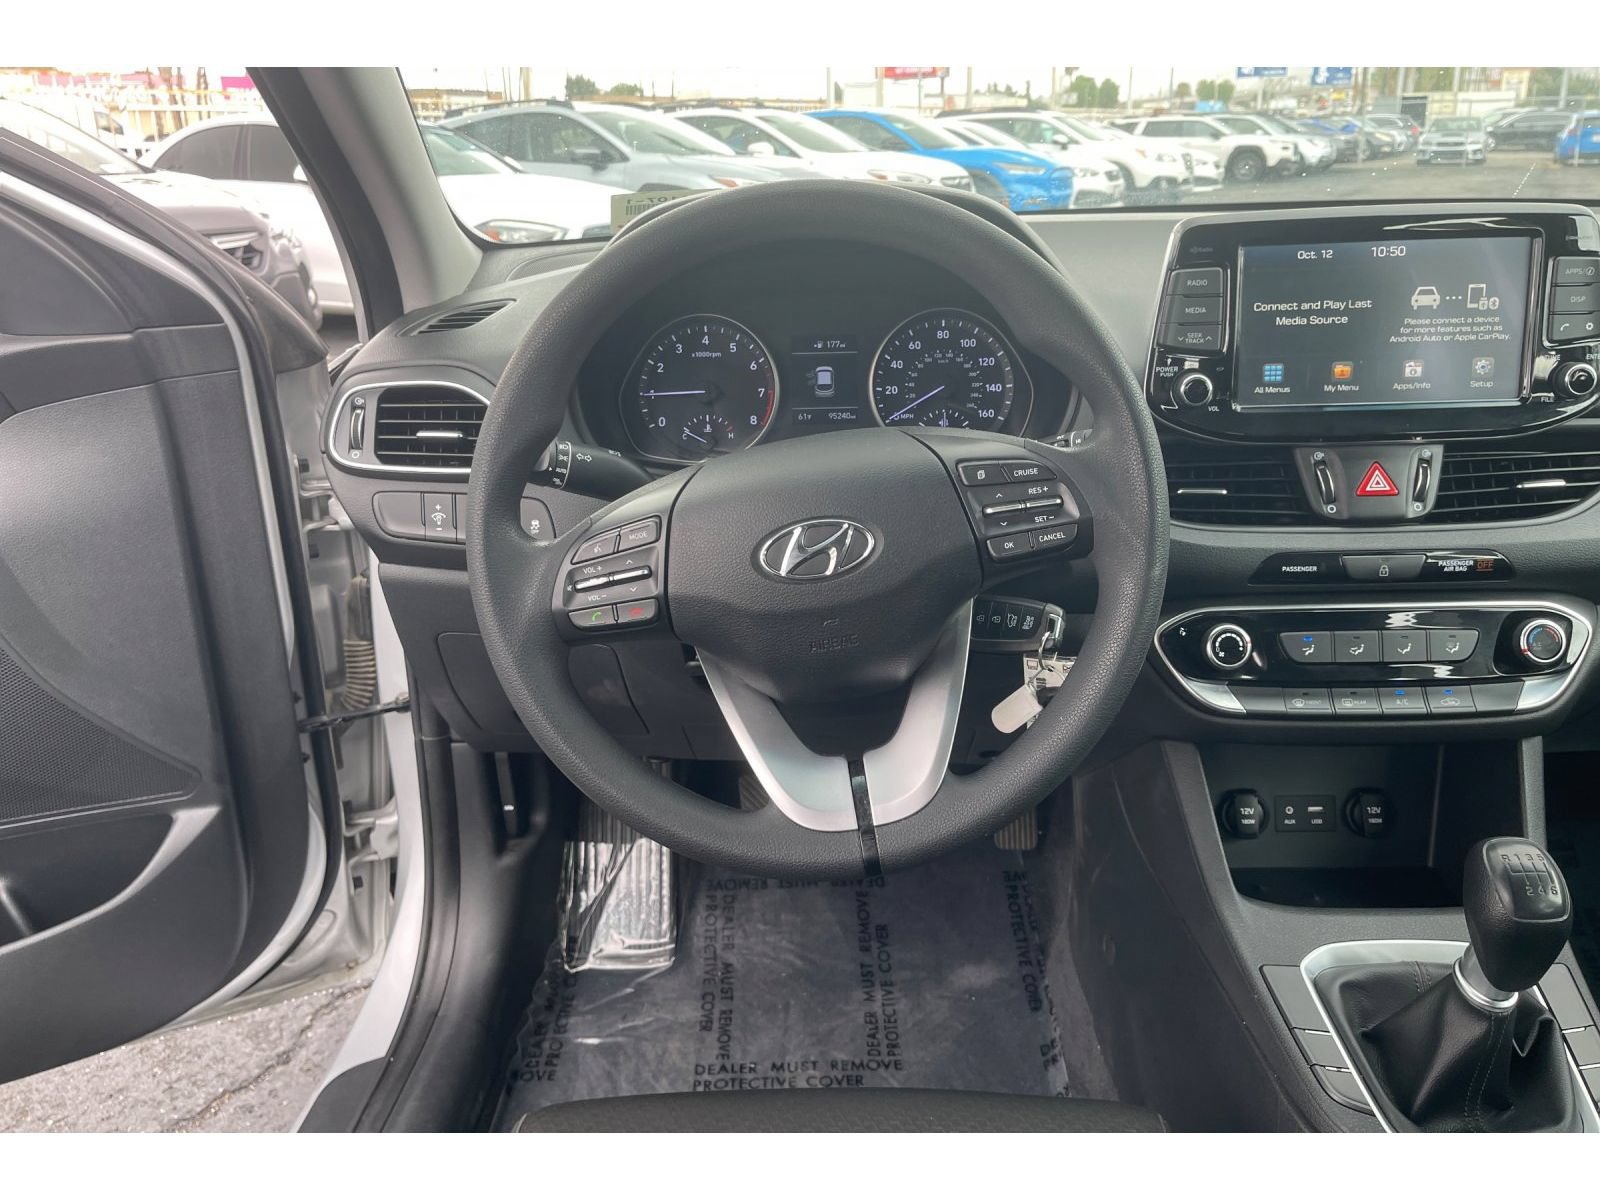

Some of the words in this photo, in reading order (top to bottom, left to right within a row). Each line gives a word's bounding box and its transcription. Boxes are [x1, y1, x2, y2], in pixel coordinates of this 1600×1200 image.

[1298, 250, 1317, 259] Oct.
[1322, 250, 1333, 259] 12
[1372, 246, 1406, 257] 10:50
[1254, 302, 1298, 312] Connect
[1301, 301, 1320, 310] and
[1324, 300, 1346, 310] Play
[1349, 300, 1372, 308] Last
[1276, 316, 1307, 325] Media
[1310, 316, 1348, 324] Source
[702, 335, 709, 345] 4
[960, 339, 976, 347] 100
[676, 344, 682, 353] 3
[730, 343, 737, 352] 5
[908, 341, 921, 350] 60
[657, 363, 664, 373] 2
[750, 361, 758, 370] 6
[890, 360, 903, 368] 40
[986, 384, 1002, 392] 140
[1393, 382, 1430, 390] Apps/Info
[1470, 380, 1493, 388] Setup
[758, 388, 765, 398] 7
[886, 386, 898, 394] 20
[658, 417, 666, 426] 0
[750, 416, 757, 425] 8
[1014, 468, 1038, 476] CRUISE
[629, 531, 648, 540] MODE
[1039, 532, 1066, 542] CANCEL
[1477, 560, 1493, 569] OFF
[706, 878, 768, 890] REMOVE
[1526, 886, 1534, 895] 2
[1551, 886, 1558, 895] 6
[721, 895, 735, 950] DEALER
[856, 888, 872, 952] REMOVE
[1008, 880, 1032, 969] PROTECTIVE
[703, 894, 719, 985] PROTECTIVE
[876, 924, 892, 973] COVER
[720, 962, 735, 1001] MUST
[860, 962, 875, 1001] MUST
[700, 992, 715, 1032] COVER
[880, 980, 900, 1057] PROTECTIVE
[716, 1003, 733, 1060] REMOVE
[867, 1012, 881, 1057] DEALER
[695, 1062, 757, 1076] DEALER
[771, 1061, 819, 1073] MUST
[831, 1059, 903, 1072] REMOVE
[693, 1076, 798, 1091] PROTECTIVE
[806, 1075, 864, 1087] COVER
